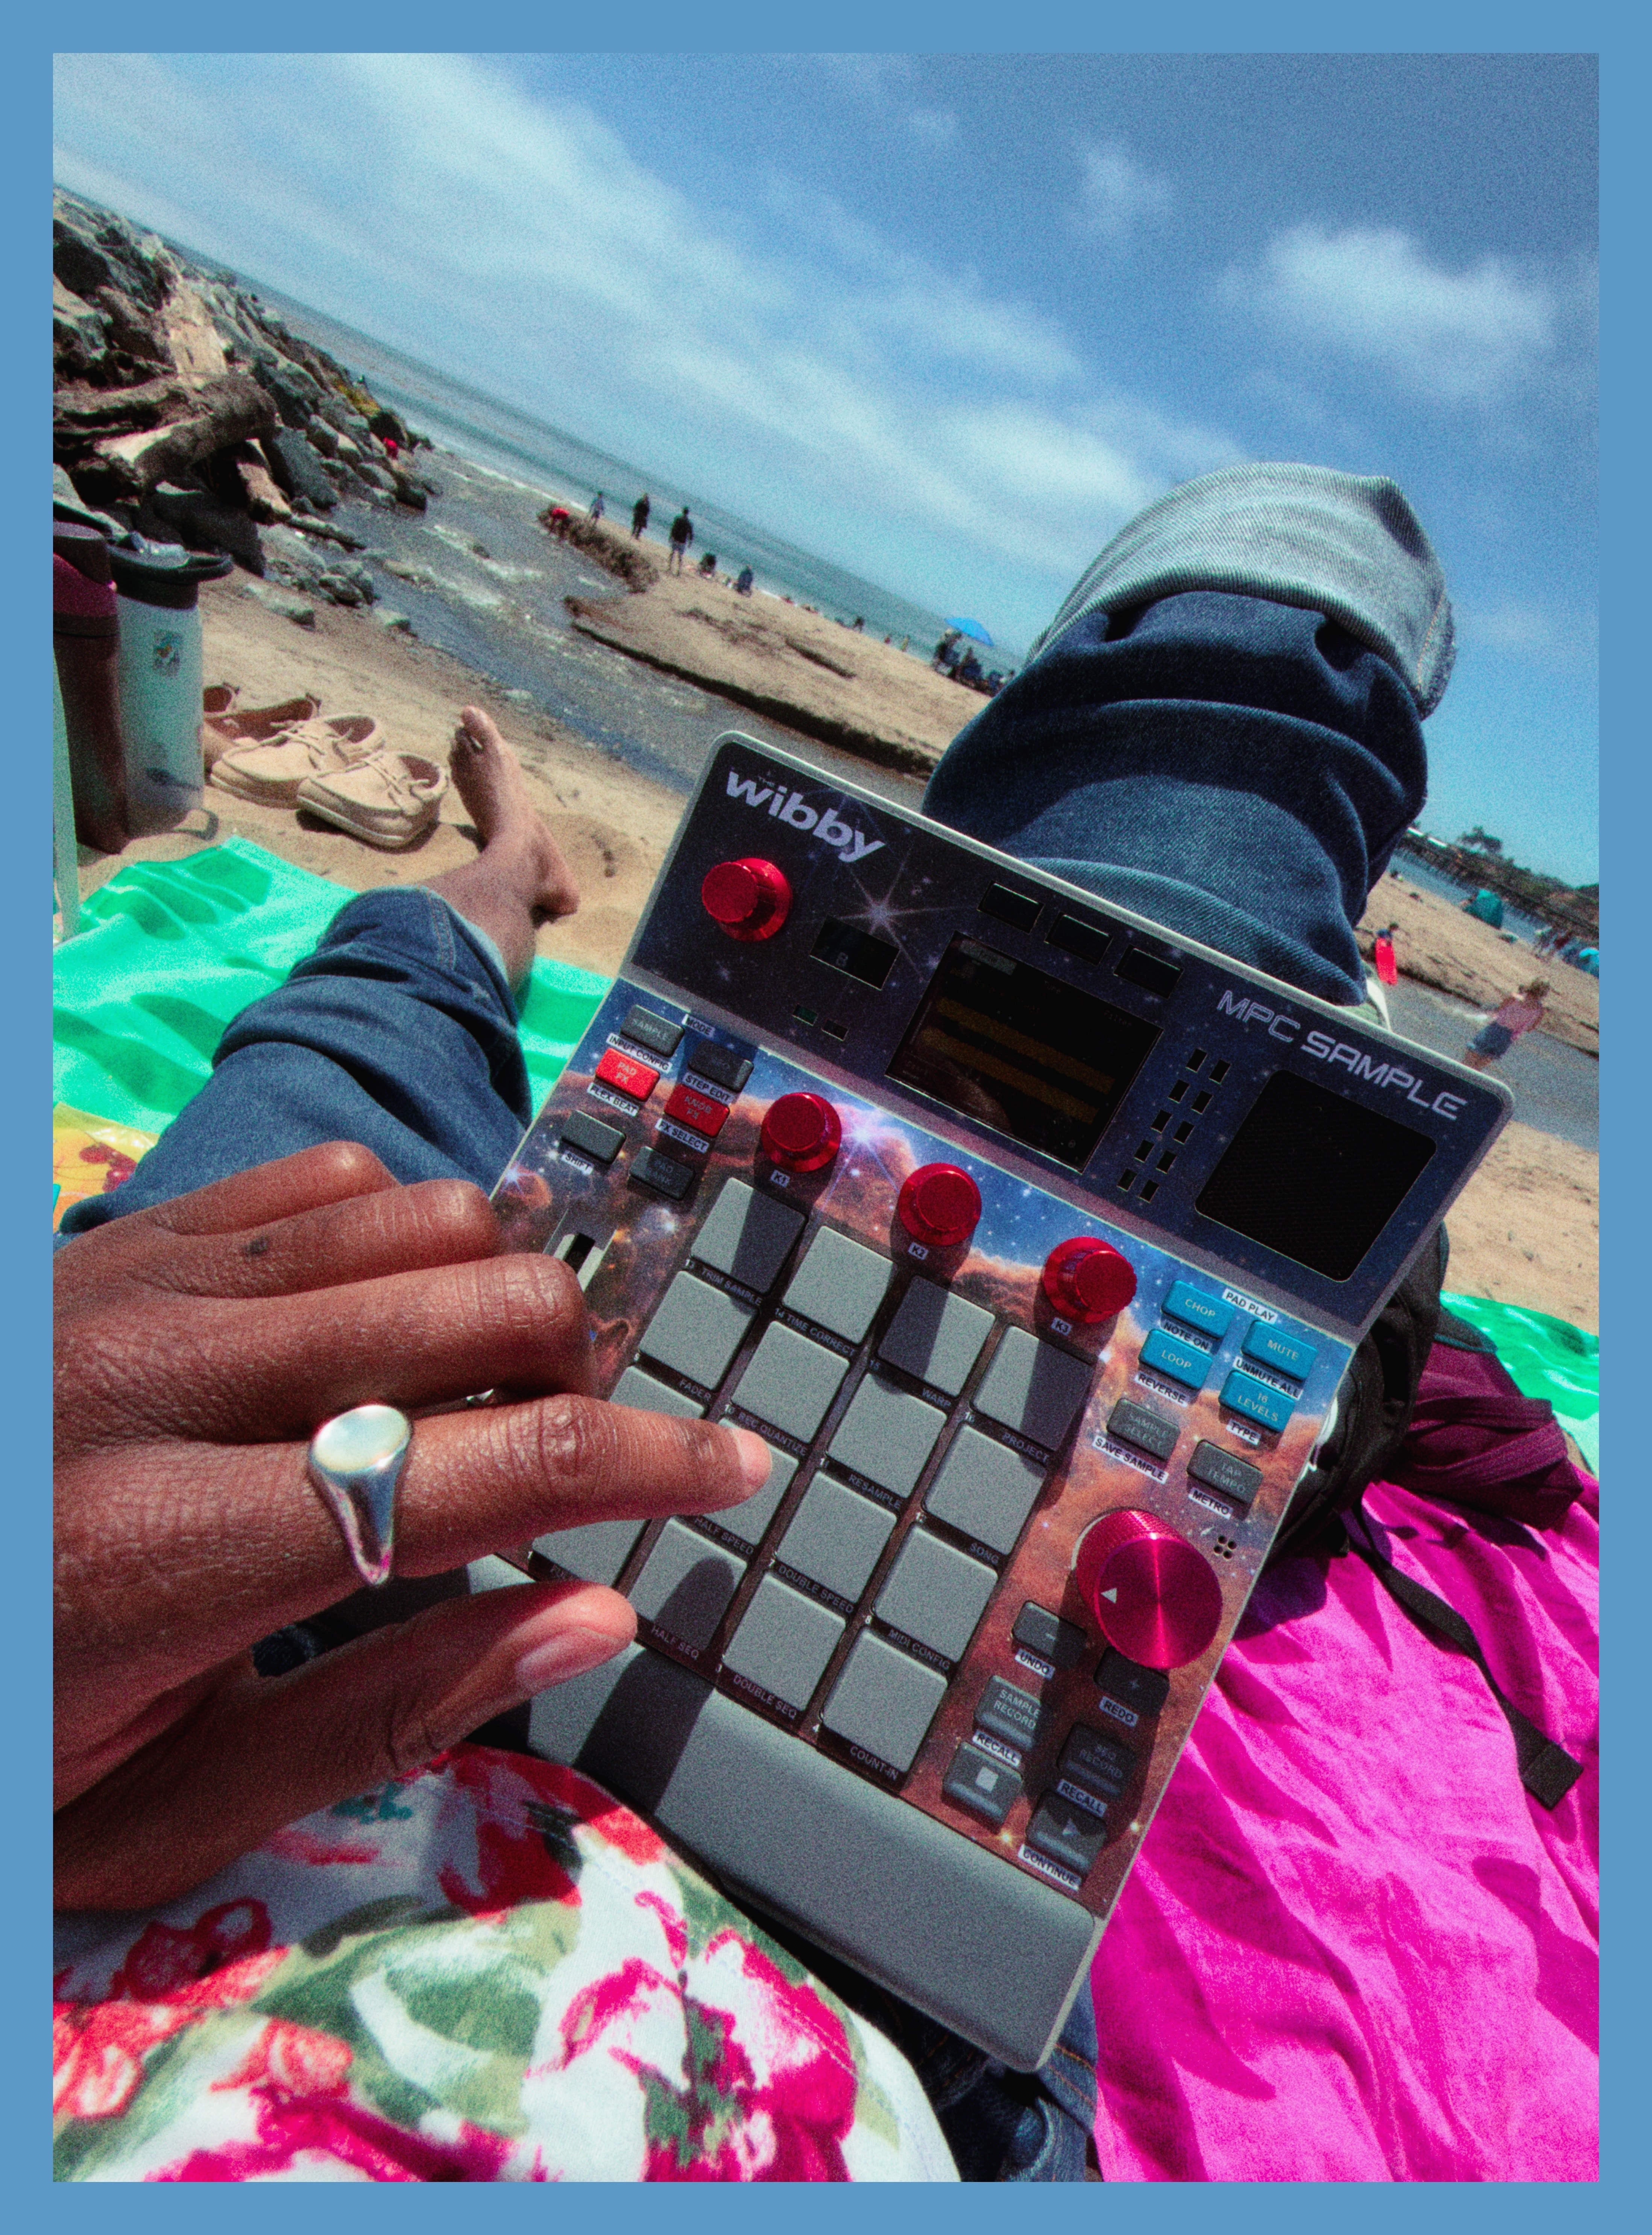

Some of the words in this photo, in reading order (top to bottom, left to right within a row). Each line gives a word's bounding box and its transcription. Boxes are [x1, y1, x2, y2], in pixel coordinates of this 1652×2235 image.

[726, 771, 886, 862] wibby
[631, 1017, 669, 1042] SAMPLE
[684, 1017, 713, 1037] MODE
[609, 1034, 638, 1055] INPUT
[637, 1049, 670, 1072] CONFIG
[1216, 989, 1302, 1045] MPC
[1301, 1028, 1467, 1122] SAMPLE
[615, 1072, 630, 1084] FX
[616, 1061, 637, 1077] PAD
[684, 1073, 710, 1092] STEP
[709, 1086, 731, 1104] EDIT
[612, 1096, 638, 1114] BEAT
[683, 1094, 712, 1114] KNOB
[686, 1108, 700, 1120] FX
[671, 1127, 707, 1151] SELECT
[772, 1172, 787, 1186] K1
[911, 1245, 926, 1258] K2
[700, 1268, 724, 1285] TRIM
[723, 1280, 763, 1307] SAMPLE
[773, 1307, 785, 1318] 14
[1184, 1298, 1216, 1319] CHOP
[1224, 1292, 1247, 1309] PAD
[1247, 1303, 1275, 1323] PLAY
[785, 1313, 809, 1332] TIME
[809, 1326, 856, 1357] CORRECT
[1054, 1320, 1069, 1333] K3
[1162, 1321, 1192, 1342] NOTE
[1192, 1337, 1210, 1352] ON
[1160, 1349, 1192, 1371] LOOP
[1266, 1339, 1300, 1362] MUTE
[868, 1360, 881, 1371] 15
[1234, 1359, 1280, 1388] UNMUTE
[1278, 1382, 1301, 1399] ALL
[678, 1379, 712, 1403] FADER
[920, 1388, 952, 1409] WARP
[1137, 1373, 1186, 1404] REVERSE
[1256, 1392, 1269, 1404] 16
[1236, 1395, 1280, 1423] LEVELS
[737, 1412, 759, 1429] REC
[758, 1424, 808, 1457] QUANTIZE
[1124, 1423, 1164, 1450] SELECT
[1127, 1412, 1168, 1438] SAMPLE
[1229, 1422, 1259, 1443] TYPE
[1001, 1432, 1050, 1463] PROJECT
[1094, 1438, 1124, 1458] SAVE
[1122, 1453, 1166, 1482] SAMPLE
[1206, 1468, 1247, 1495] TEMPO
[1220, 1462, 1242, 1479] TAP
[848, 1474, 902, 1510] RESAMPLE
[1191, 1490, 1231, 1517] METRO
[720, 1532, 755, 1556] SPEED
[969, 1541, 1001, 1565] SONG
[777, 1564, 820, 1594] DOUBLE
[820, 1589, 855, 1614] SPEED
[650, 1625, 677, 1646] HALF
[677, 1641, 700, 1661] SEQ
[888, 1629, 911, 1647] MIDI
[910, 1641, 952, 1671] CONFIG
[1018, 1652, 1051, 1676] UNDO
[732, 1674, 774, 1705] DOUBLE
[774, 1700, 798, 1720] SEQ
[999, 1689, 1041, 1718] SAMPLE
[993, 1700, 1037, 1731] RECORD
[1103, 1700, 1135, 1724] REDO
[976, 1733, 1020, 1764] RECALL
[1078, 1749, 1124, 1780] RECORD
[1060, 1783, 1104, 1814] RECALL
[1021, 1848, 1078, 1887] CONTINUE
